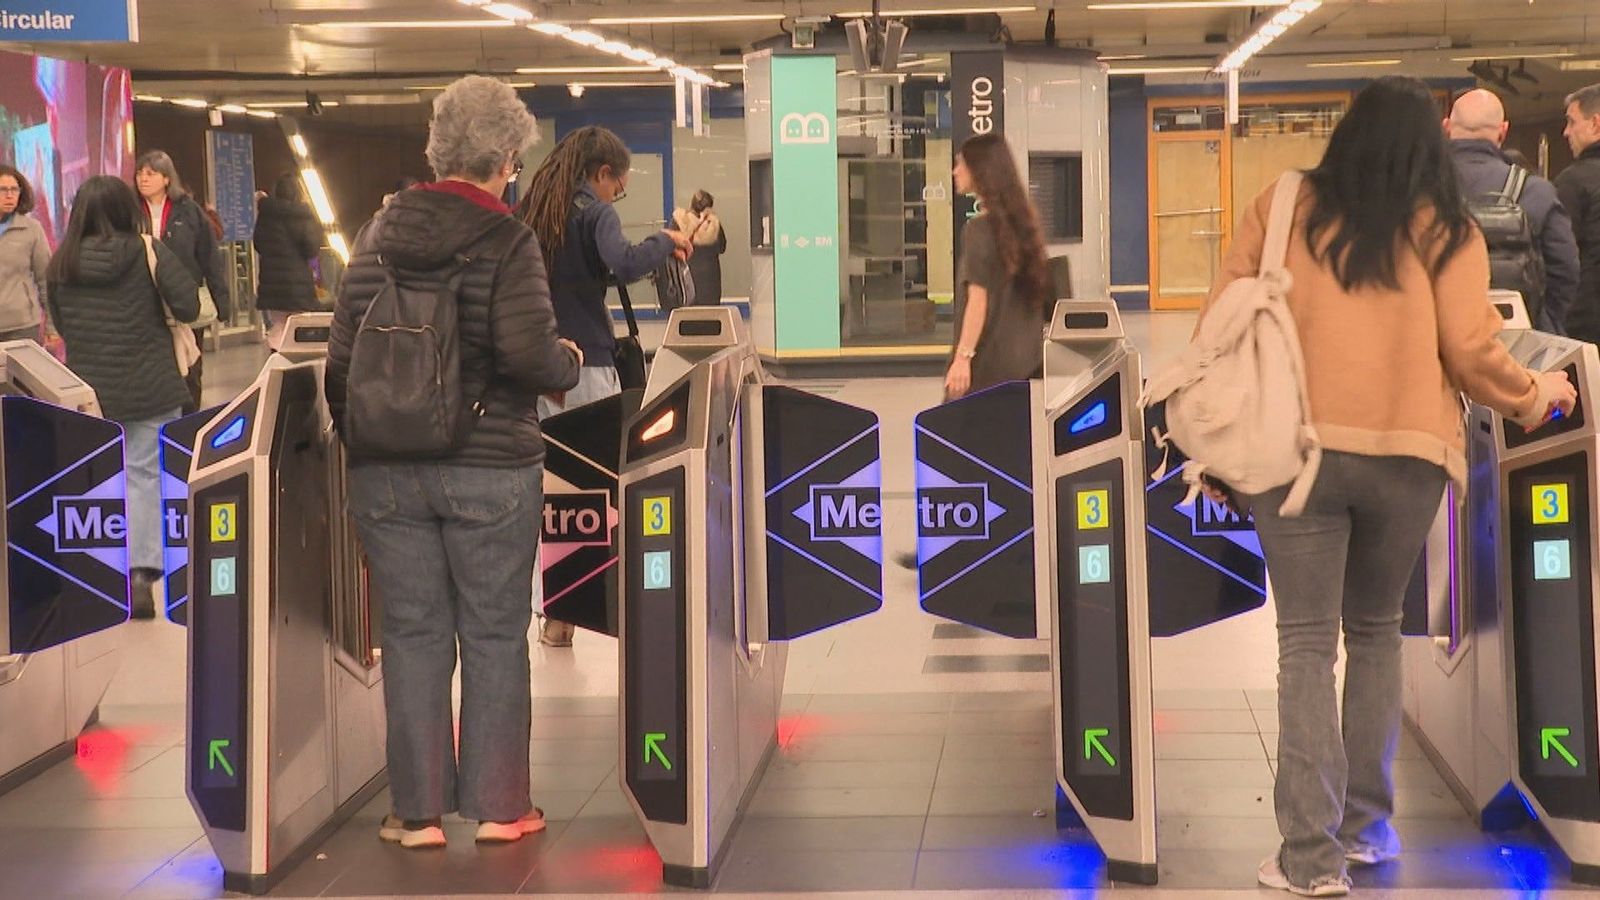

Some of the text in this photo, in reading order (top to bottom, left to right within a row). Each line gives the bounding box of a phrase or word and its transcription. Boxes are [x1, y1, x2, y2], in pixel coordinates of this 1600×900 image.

[0, 9, 75, 30] ircular
[968, 76, 993, 136] etro
[780, 112, 830, 144] B
[542, 503, 601, 535] tro
[650, 502, 664, 531] 3
[819, 494, 979, 529] Me tro
[1086, 495, 1101, 525] 3
[1202, 495, 1255, 523] M
[1542, 489, 1559, 519] 3
[64, 506, 127, 540] Me
[217, 508, 230, 537] 3
[650, 555, 665, 585] 6
[1086, 550, 1102, 579] 6
[1542, 546, 1562, 576] 6
[216, 562, 230, 591] 6
